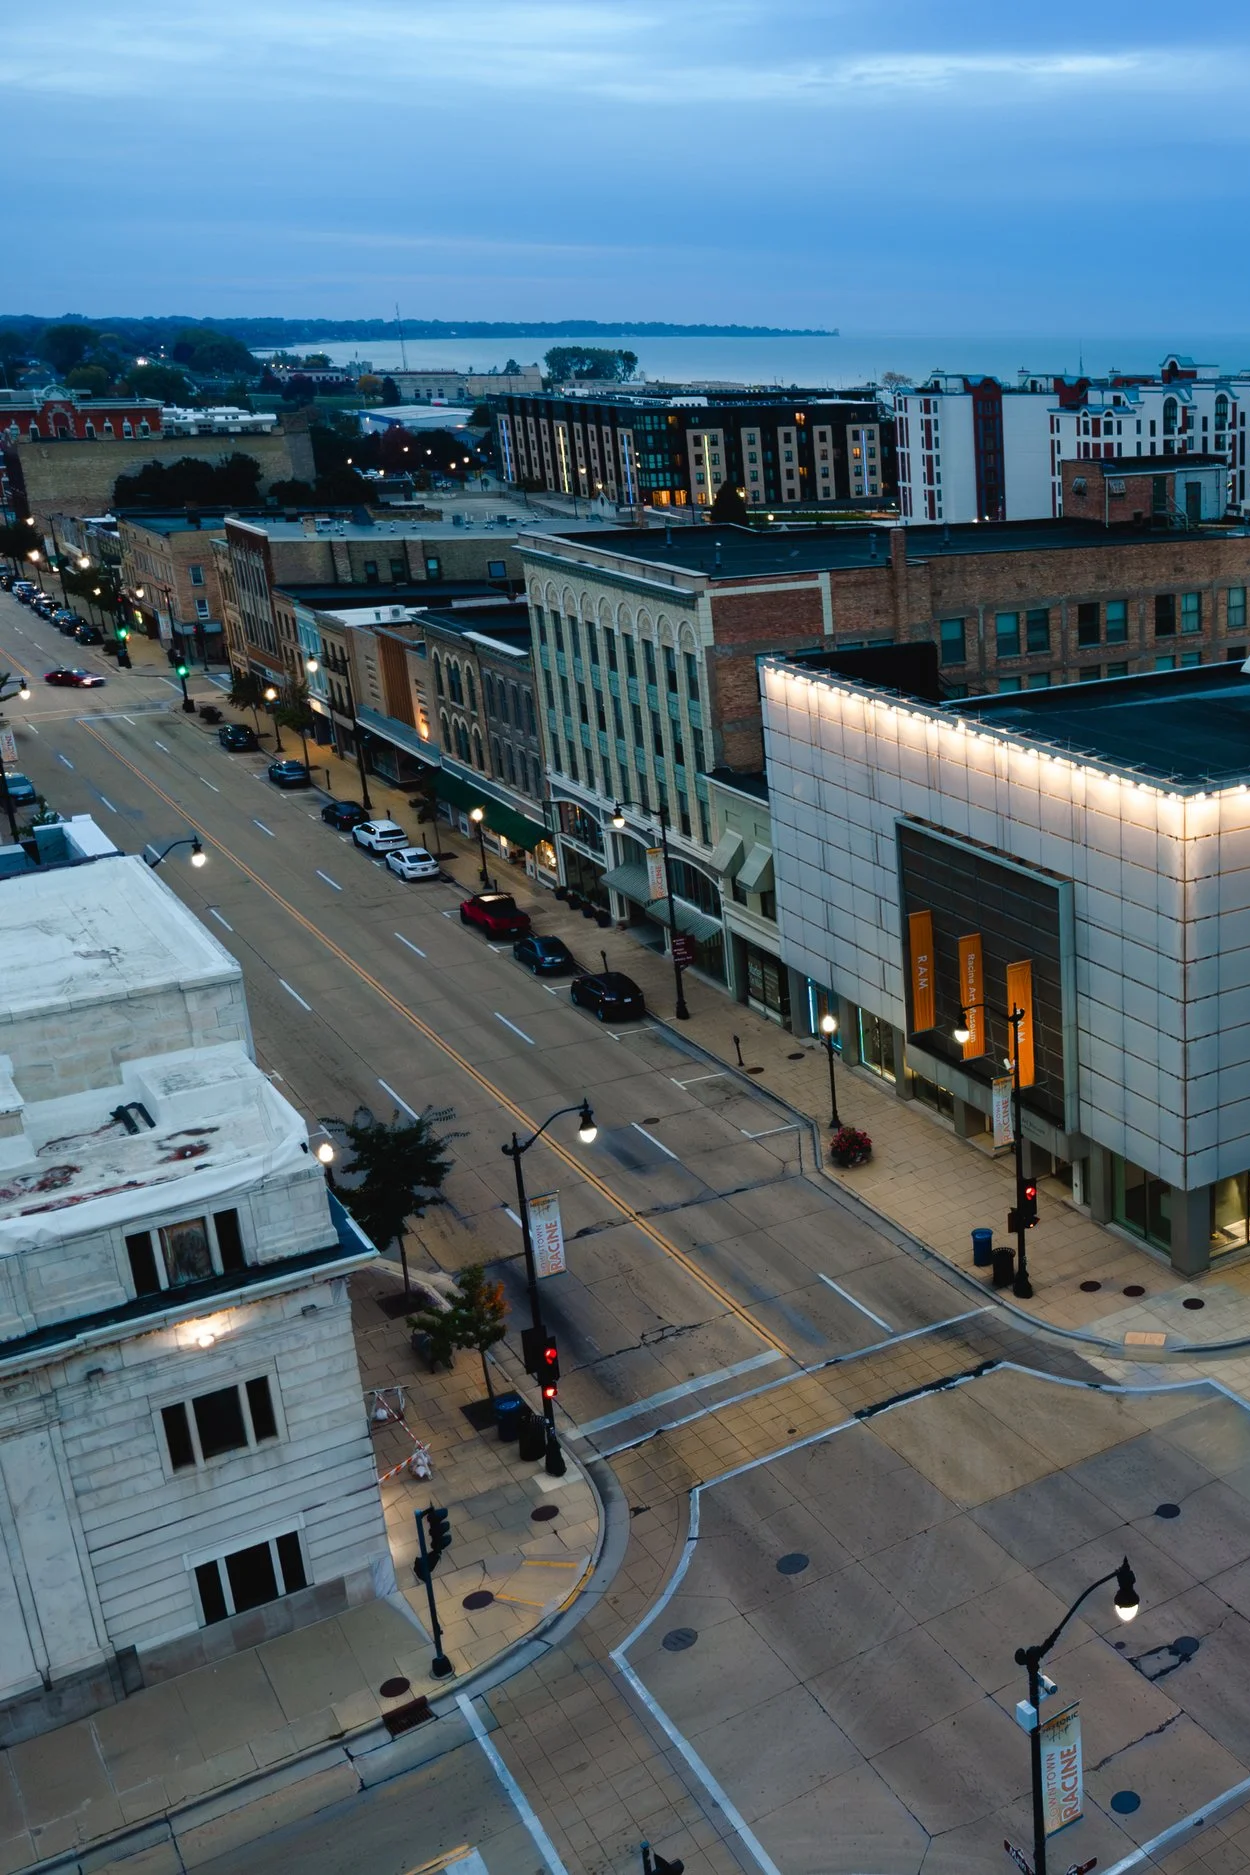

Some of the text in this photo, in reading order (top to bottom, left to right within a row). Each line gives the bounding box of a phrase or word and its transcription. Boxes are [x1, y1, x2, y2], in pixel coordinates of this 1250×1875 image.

[655, 865, 665, 898] RACINE
[917, 955, 929, 991] RAM
[967, 953, 977, 1043] Racine Art Museum
[1015, 1008, 1026, 1044] AM
[1001, 1098, 1011, 1141] RACINE
[545, 1220, 563, 1271] RACINE
[1046, 1752, 1060, 1829] DOWNTOWN
[1061, 1743, 1080, 1822] RACINE
